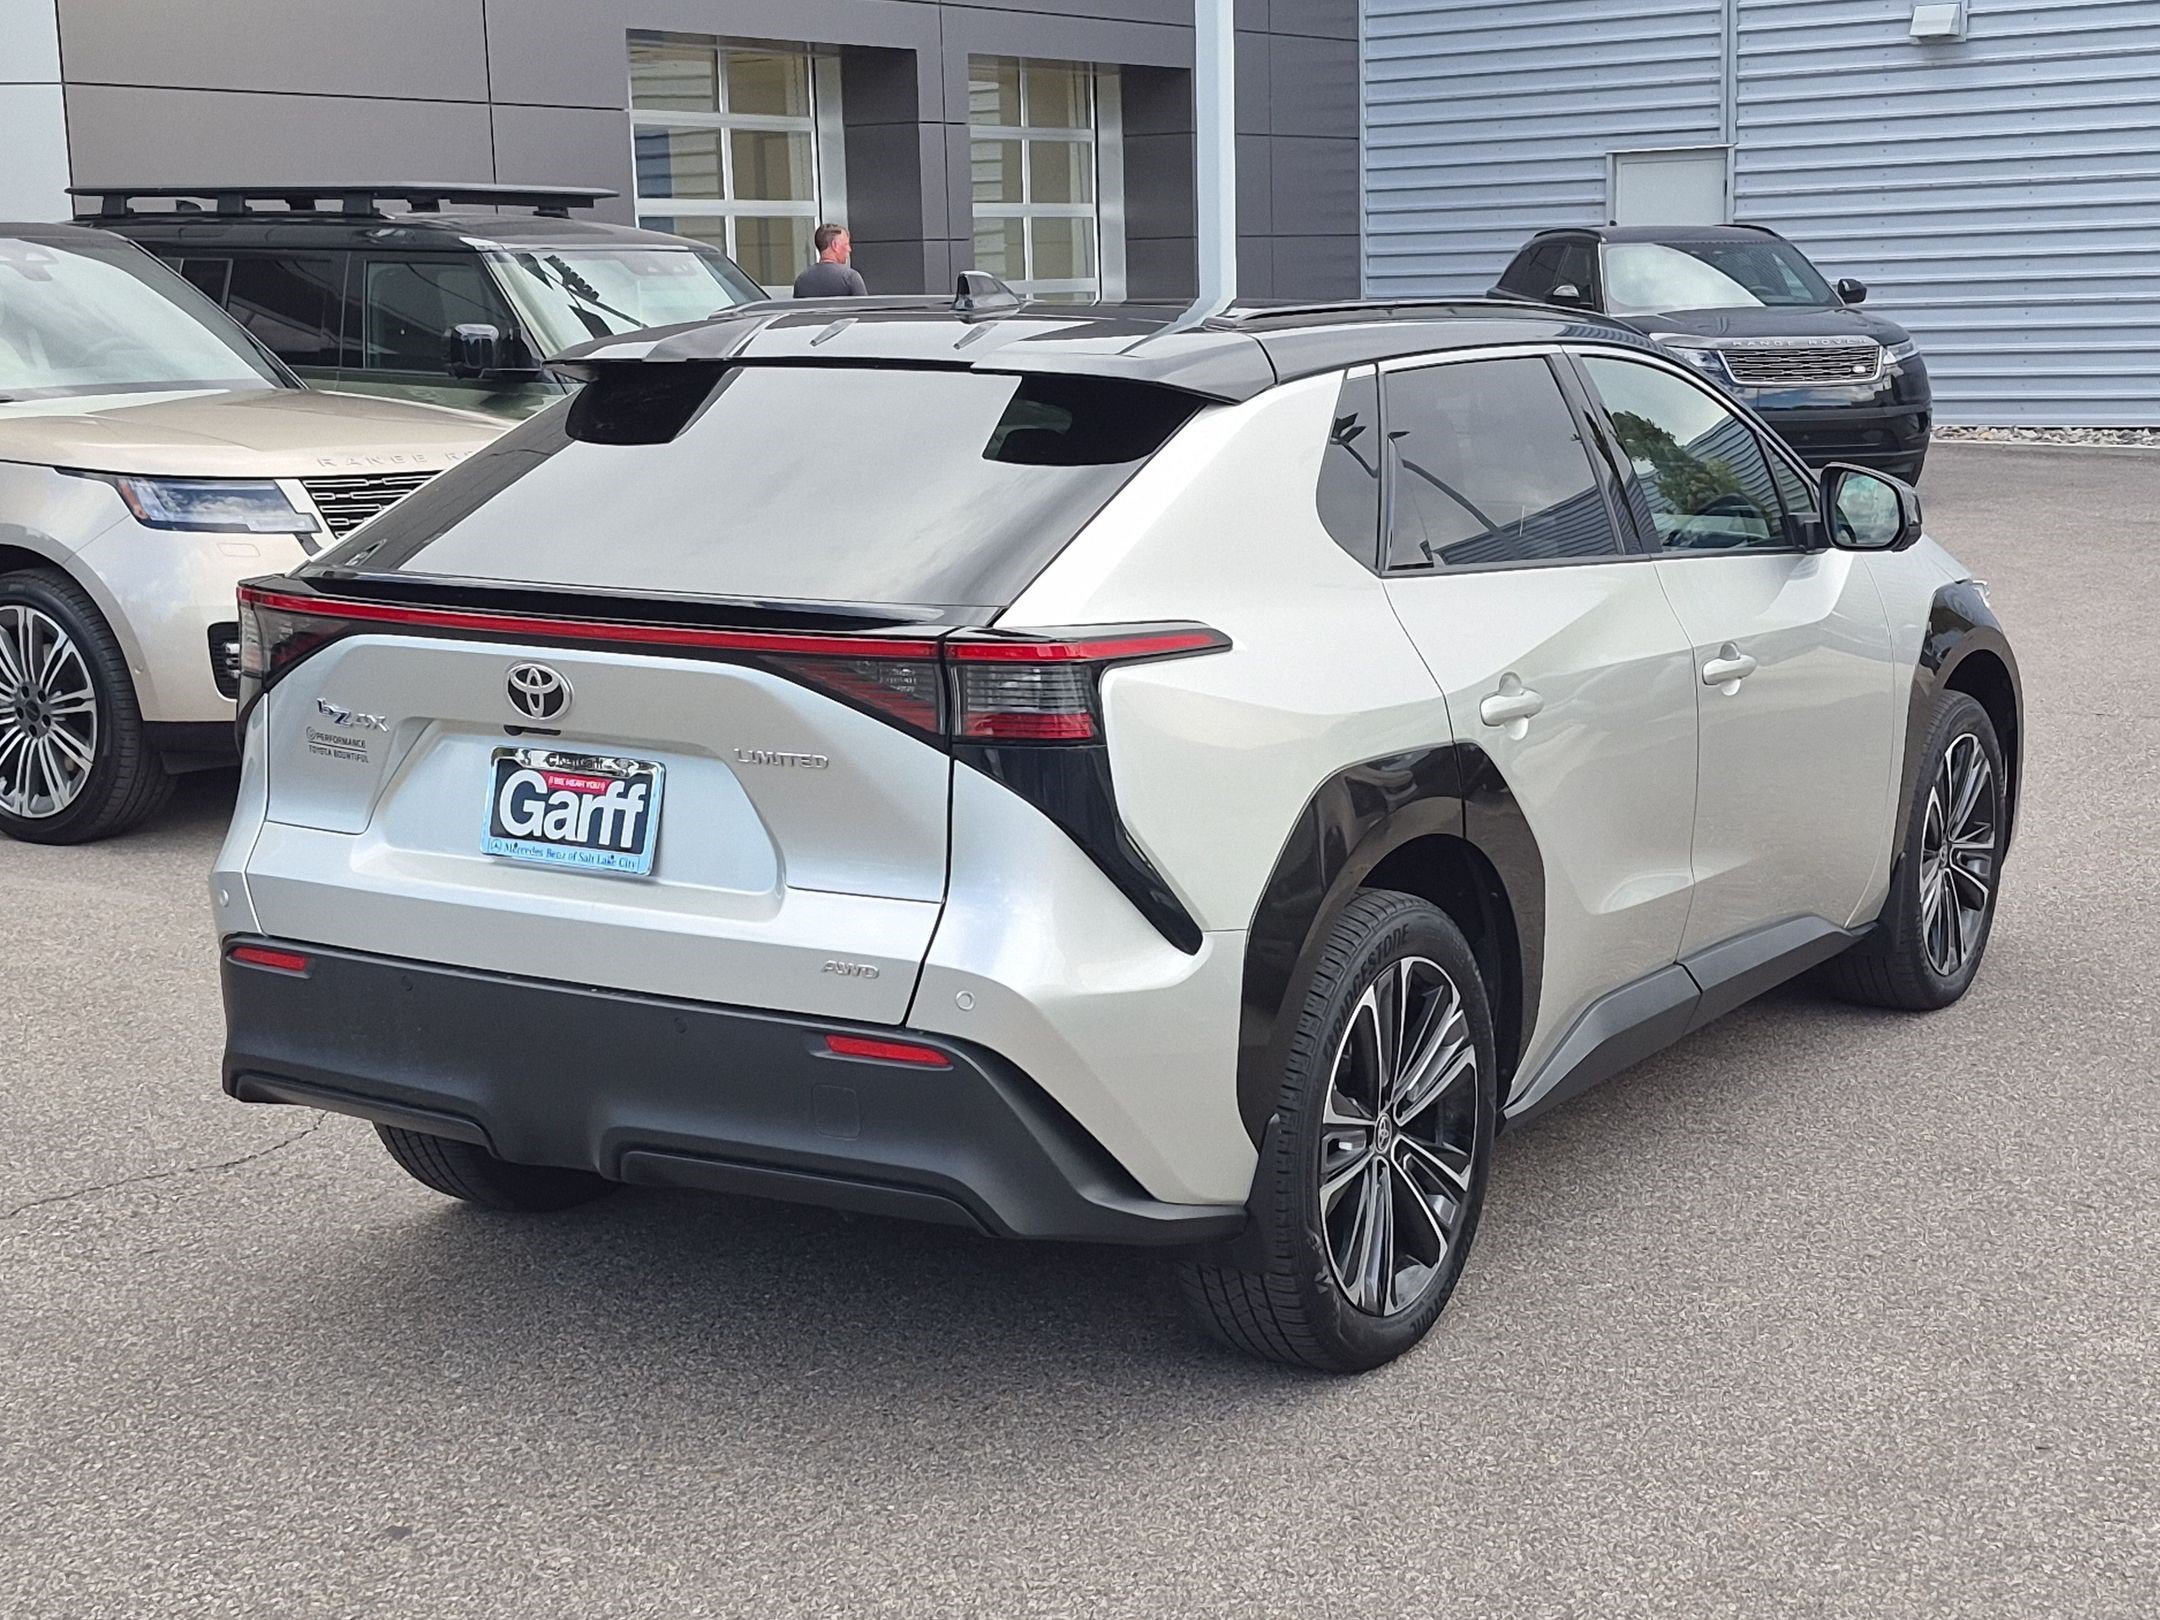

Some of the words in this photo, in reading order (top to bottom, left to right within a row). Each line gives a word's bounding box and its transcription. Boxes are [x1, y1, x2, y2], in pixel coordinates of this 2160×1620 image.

[316, 454, 427, 468] RANGE
[733, 747, 830, 769] LIMITED
[499, 769, 647, 848] Garff
[568, 850, 578, 862] of
[579, 851, 595, 864] Salt
[597, 854, 617, 867] Lake
[821, 959, 881, 979] AWD
